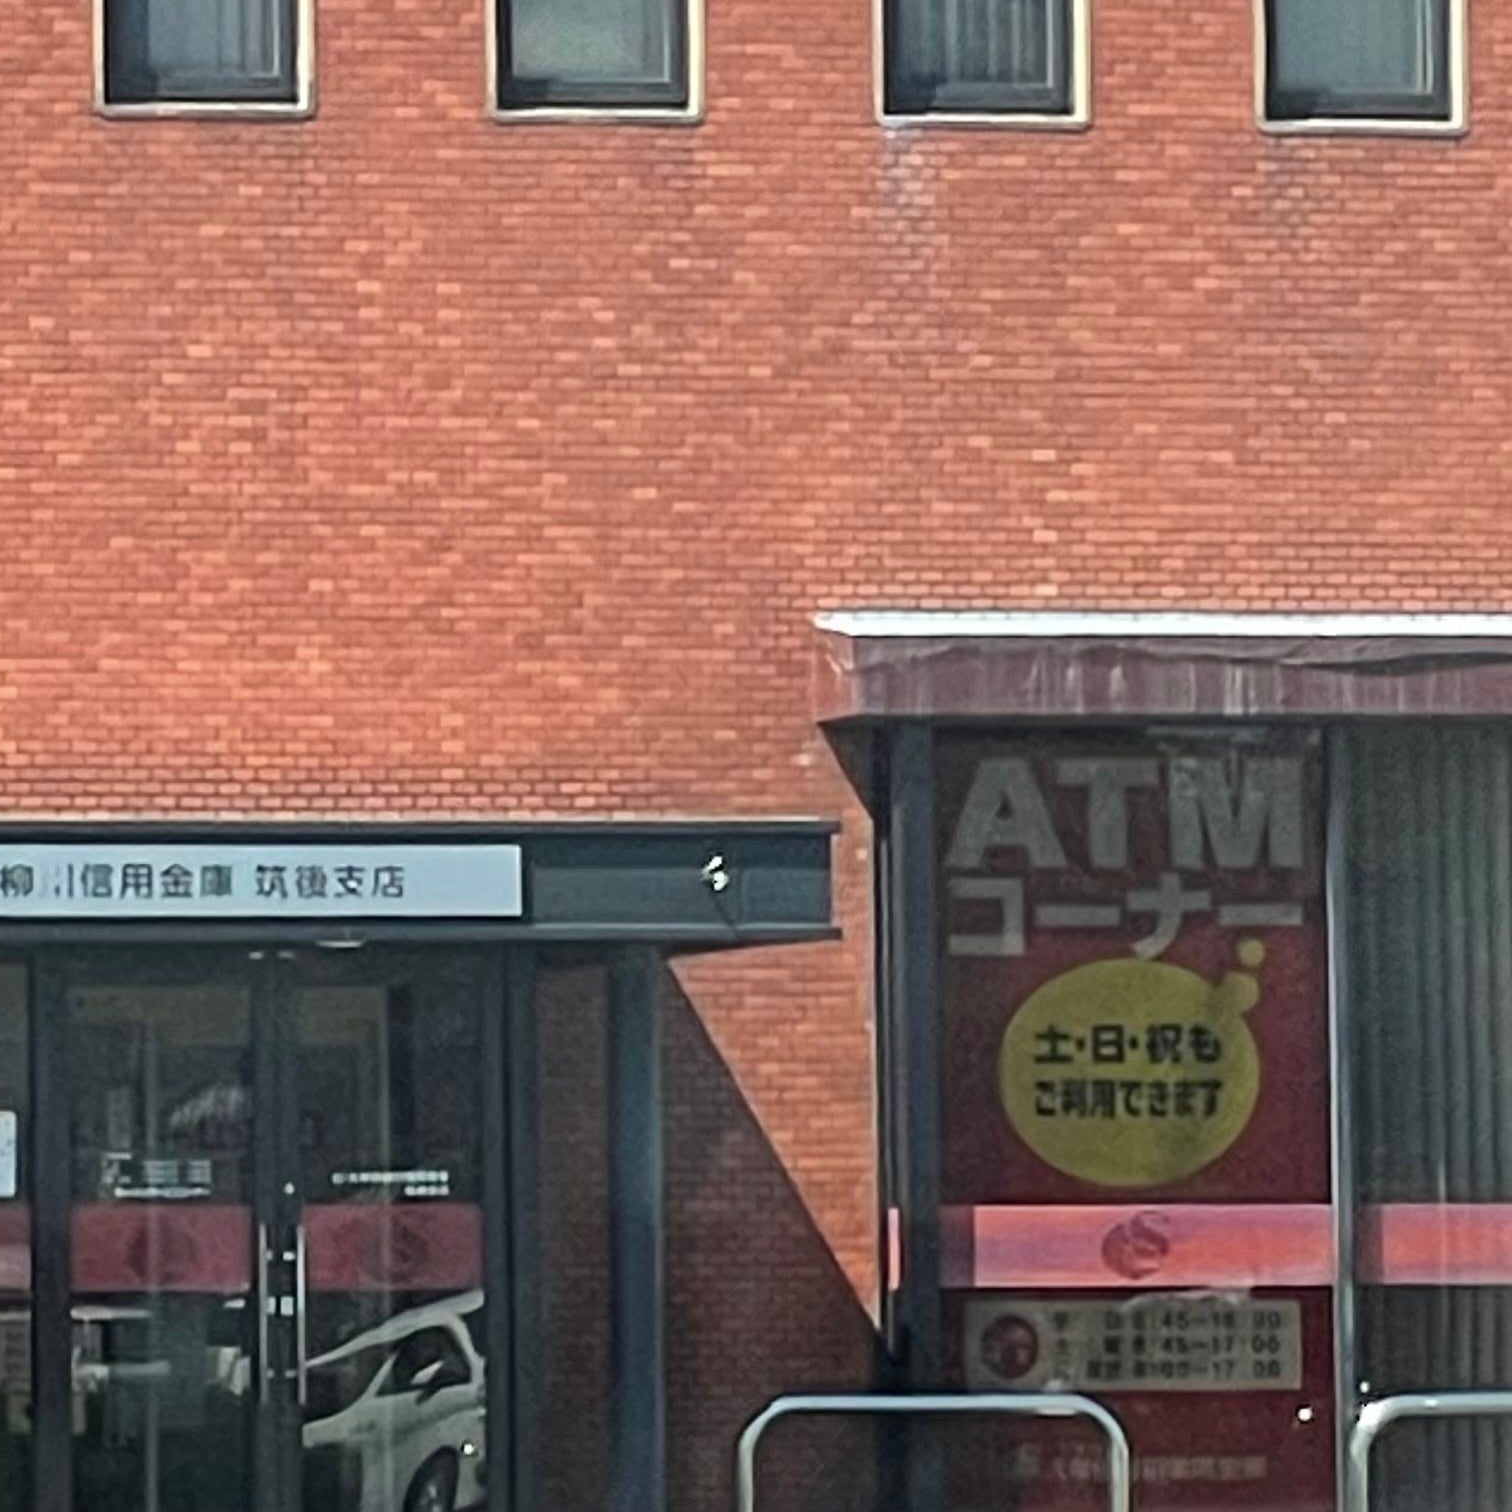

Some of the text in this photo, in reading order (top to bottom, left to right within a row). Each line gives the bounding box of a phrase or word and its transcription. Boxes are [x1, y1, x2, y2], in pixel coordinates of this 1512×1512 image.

[944, 757, 1304, 869] ATM
[255, 863, 406, 900] 筑後支店
[947, 872, 1304, 959] コーナー
[1034, 1078, 1225, 1119] ご利用できます
